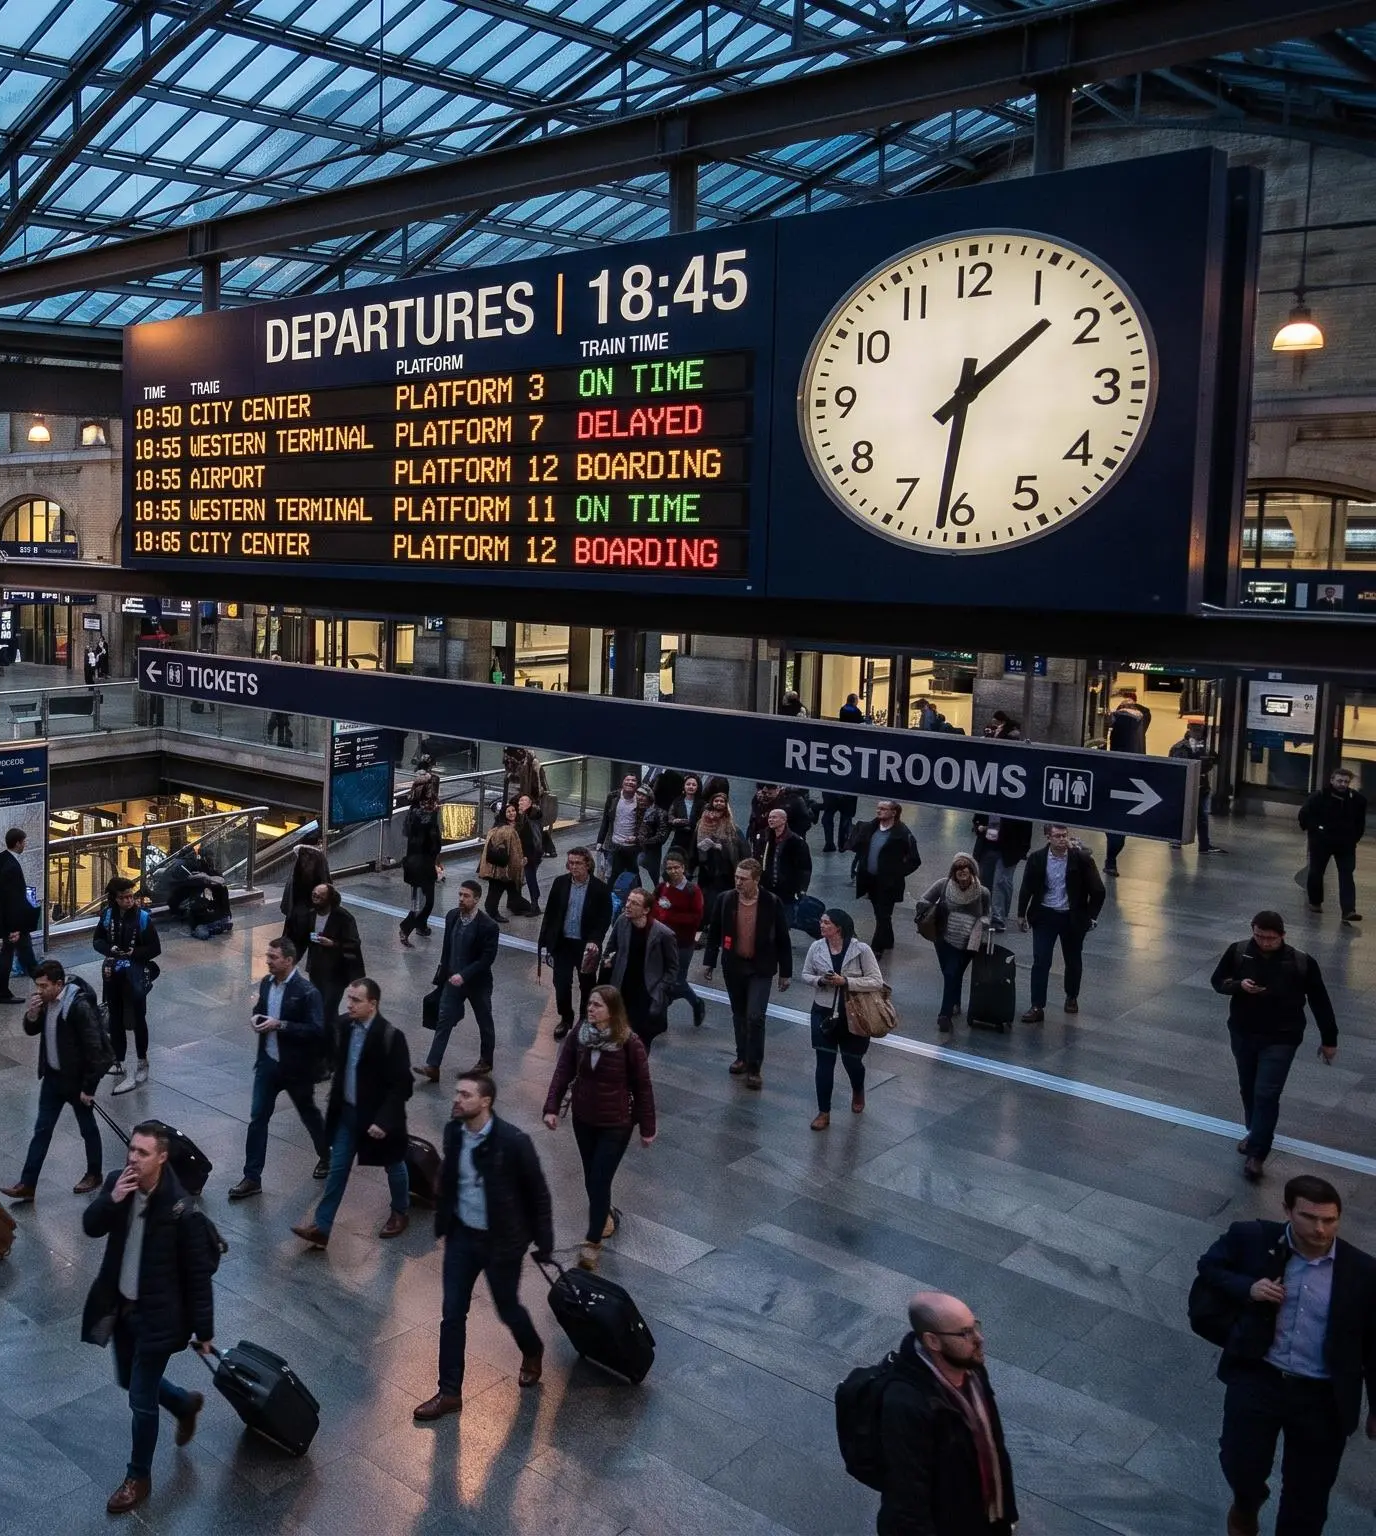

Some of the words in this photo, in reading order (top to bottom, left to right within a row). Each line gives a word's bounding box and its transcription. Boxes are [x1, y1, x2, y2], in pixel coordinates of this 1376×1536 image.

[957, 262, 993, 298] 12
[1034, 270, 1042, 305] 1
[266, 281, 534, 364] DEPARTURES
[587, 249, 749, 325] 18:45
[903, 285, 927, 321] 11
[1072, 307, 1101, 345] 2
[580, 337, 625, 358] TRAIN
[630, 332, 669, 353] TIME
[857, 330, 890, 364] 10
[396, 354, 463, 376] PLATFORM
[136, 405, 182, 430] 18:50
[190, 401, 232, 426] CITY
[242, 394, 311, 422] CENTER
[396, 376, 513, 411] PLATFORM
[528, 373, 545, 401] 3
[578, 367, 612, 397] ON
[631, 359, 705, 393] TIME
[144, 385, 166, 400] TIME
[834, 386, 857, 418] 9
[1092, 367, 1121, 405] 3
[136, 436, 181, 460] 18:55
[190, 431, 266, 457] WESTERN
[276, 425, 374, 453] TERMINAL
[396, 415, 512, 448] PLATFORM
[528, 414, 545, 442] 7
[578, 404, 703, 439] DELAYED
[1062, 429, 1093, 466] 4
[135, 468, 181, 491] 18:55
[190, 465, 265, 489] AIRPORT
[395, 455, 511, 485] PLATFORM
[528, 454, 558, 482] 12
[577, 448, 722, 481] BOARDING
[851, 440, 874, 473] 8
[135, 500, 181, 521] 18:55
[190, 498, 266, 522] WESTERN
[276, 497, 373, 522] TERMINAL
[394, 495, 510, 522] PLATFORM
[527, 495, 555, 522] 11
[575, 494, 610, 522] ON
[628, 493, 701, 523] TIME
[896, 478, 920, 510] 7
[949, 492, 975, 526] 6
[1012, 475, 1040, 511] 5
[190, 531, 232, 554] CITY
[241, 532, 310, 556] CENTER
[393, 534, 509, 562] PLATFORM
[527, 536, 557, 563] 12
[575, 536, 718, 569] BOARDING
[187, 666, 258, 696] TICKETS
[785, 738, 1027, 799] RESTROOMS
